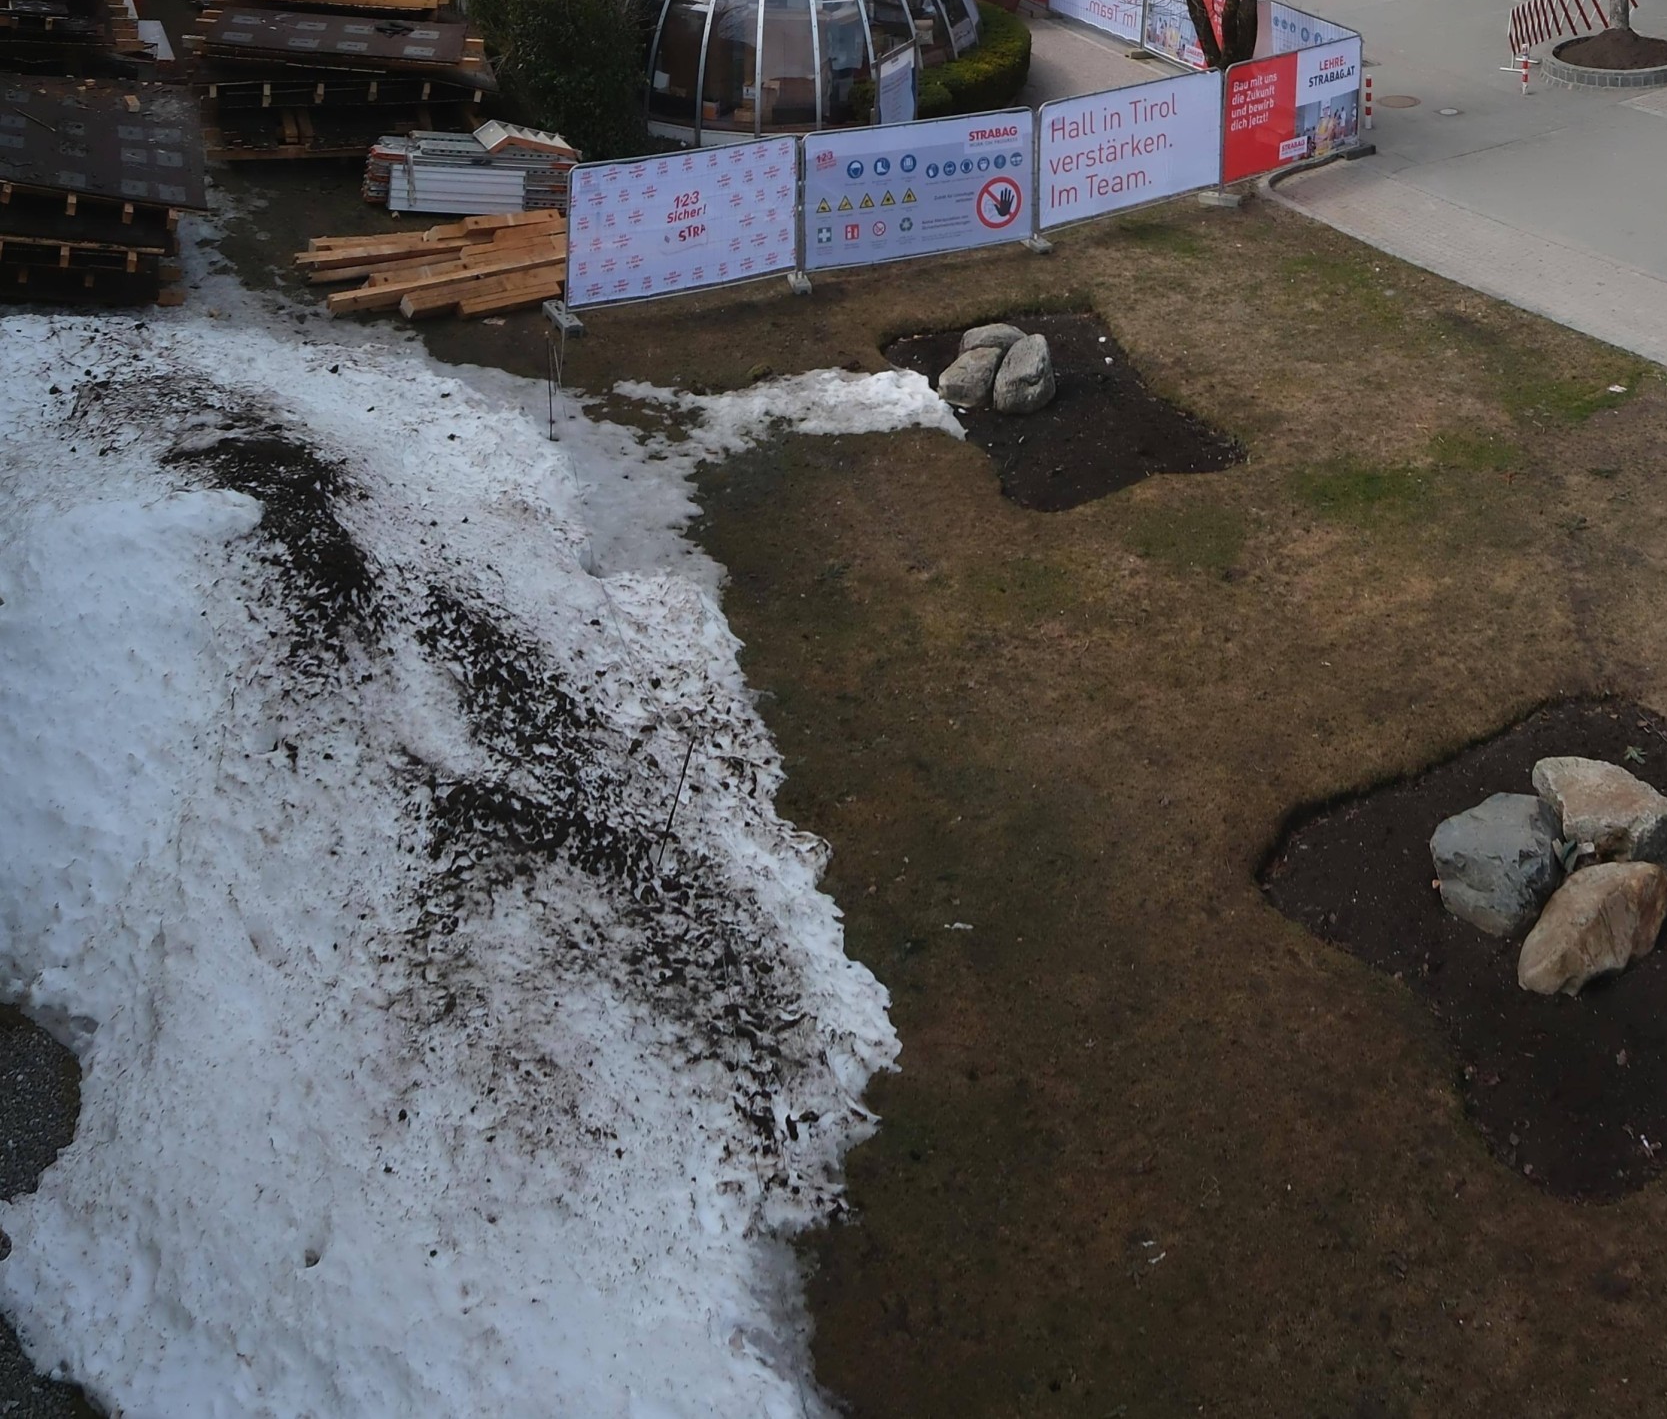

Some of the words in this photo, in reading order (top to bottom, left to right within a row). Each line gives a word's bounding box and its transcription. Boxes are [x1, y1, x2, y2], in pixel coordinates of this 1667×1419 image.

[1319, 56, 1346, 71] LEHRE.
[1233, 81, 1248, 92] Bau
[1250, 76, 1263, 88] mit
[1264, 73, 1277, 84] uns
[1308, 66, 1355, 87] STRABAG.AT
[1232, 94, 1244, 105] die
[1246, 86, 1275, 101] Zukunft
[1050, 110, 1095, 143] Hall
[1103, 106, 1121, 133] in
[1129, 93, 1177, 126] Tirol
[1231, 105, 1246, 118] und
[1248, 99, 1274, 114] bewirb
[1231, 118, 1247, 132] dich
[1249, 112, 1269, 129] jetzt!
[969, 126, 1018, 141] STRABAG
[1049, 130, 1173, 176] verstärken.
[1050, 182, 1078, 208] Im
[1086, 170, 1152, 199] Team.
[667, 204, 707, 224] Sicher!
